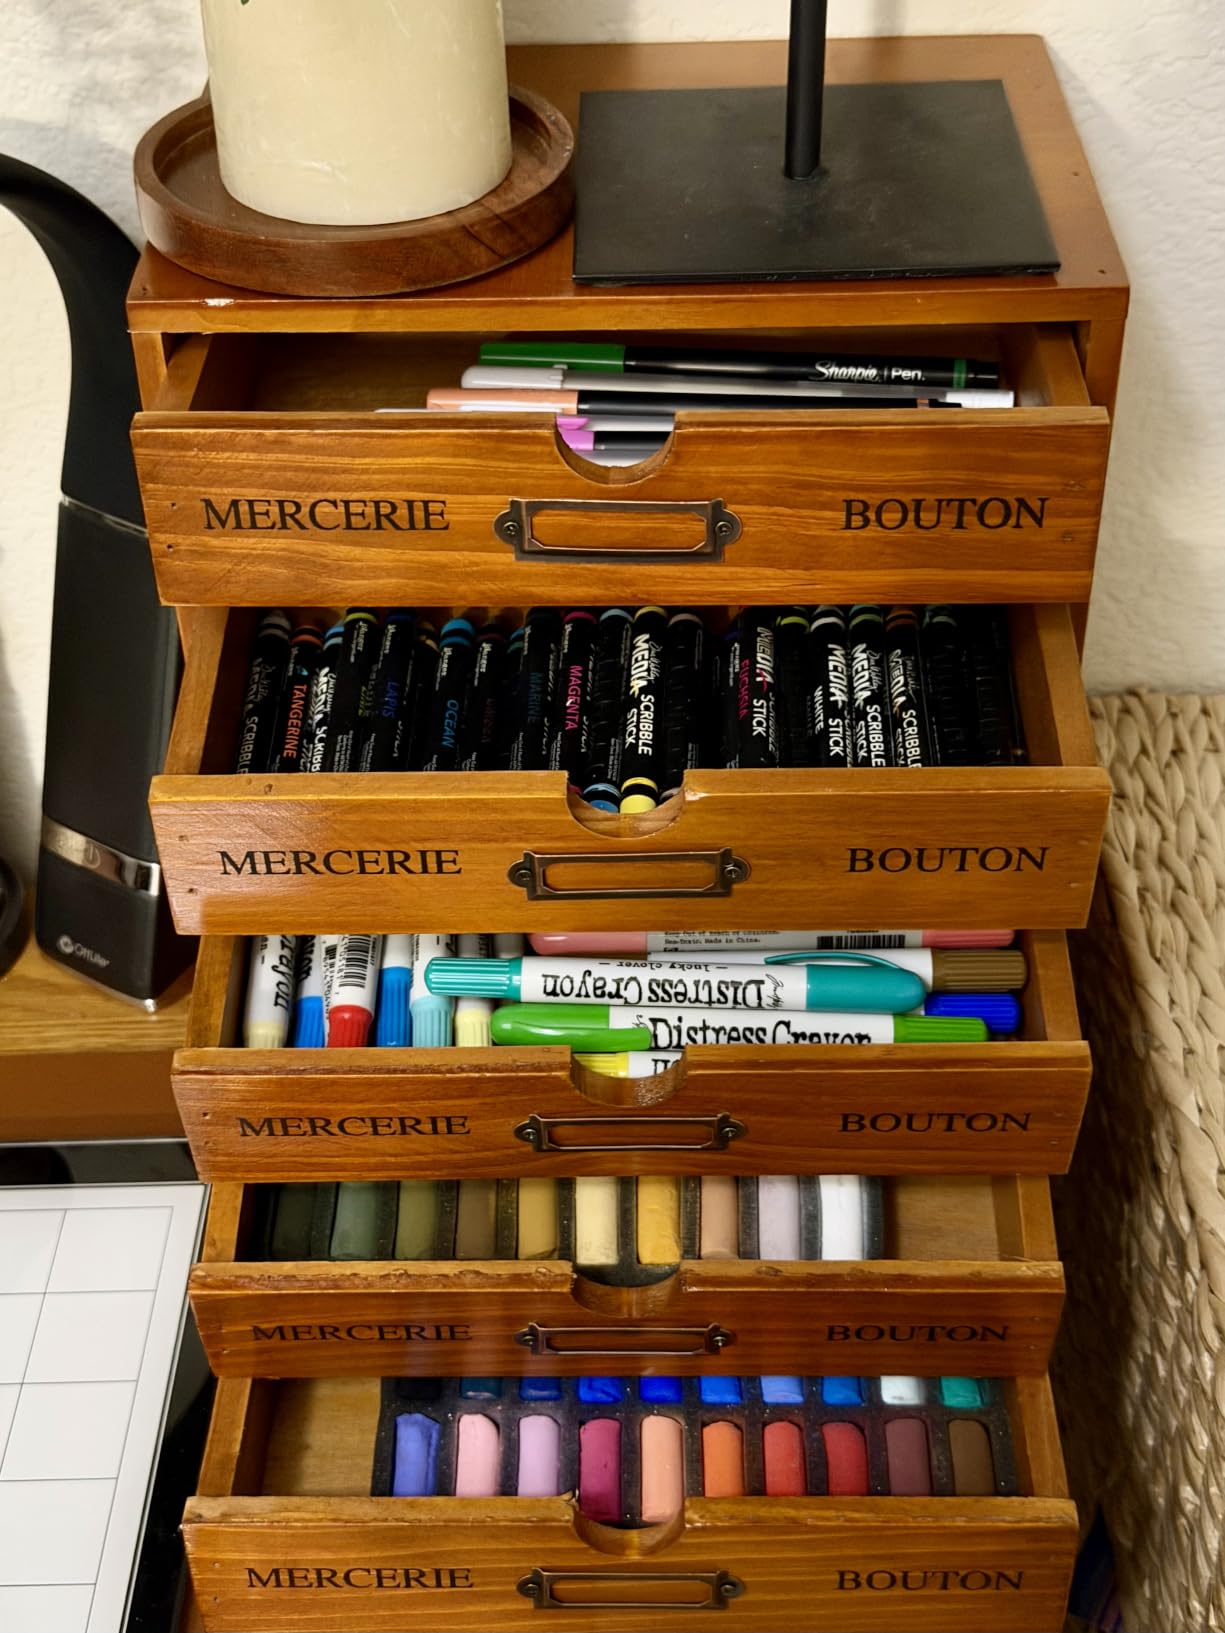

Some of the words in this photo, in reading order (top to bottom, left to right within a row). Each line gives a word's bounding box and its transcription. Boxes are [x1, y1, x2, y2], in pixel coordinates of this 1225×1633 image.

[202, 499, 449, 531] MERCERIE
[843, 497, 1049, 530] BOUTON
[629, 633, 651, 698] MEDIA
[827, 643, 849, 709] MEDIA
[851, 642, 872, 710] MEDIA
[564, 665, 583, 731] MAGENTA
[752, 698, 767, 737] STICK
[283, 684, 307, 759] TANGERINE
[441, 699, 460, 749] OCEAN
[625, 708, 638, 749] STICK
[638, 694, 655, 756] SCRIBBLE
[828, 717, 845, 757] STICK
[866, 704, 886, 768] SCRIBBLE
[220, 850, 461, 875] MERCERIE
[850, 847, 1045, 872] BOUTON
[617, 961, 662, 970] clover
[669, 962, 710, 972] lucky
[542, 970, 642, 1005] Crayon
[648, 977, 766, 1010] Distress
[649, 1015, 767, 1050] Distress
[241, 1116, 470, 1136] MERCERIE
[842, 1113, 1030, 1133] BOUTON
[254, 1324, 470, 1341] MERCERIE
[829, 1325, 1009, 1341] BOUTON
[248, 1568, 472, 1589] MERCERIE
[838, 1570, 1024, 1591] BOUTON
